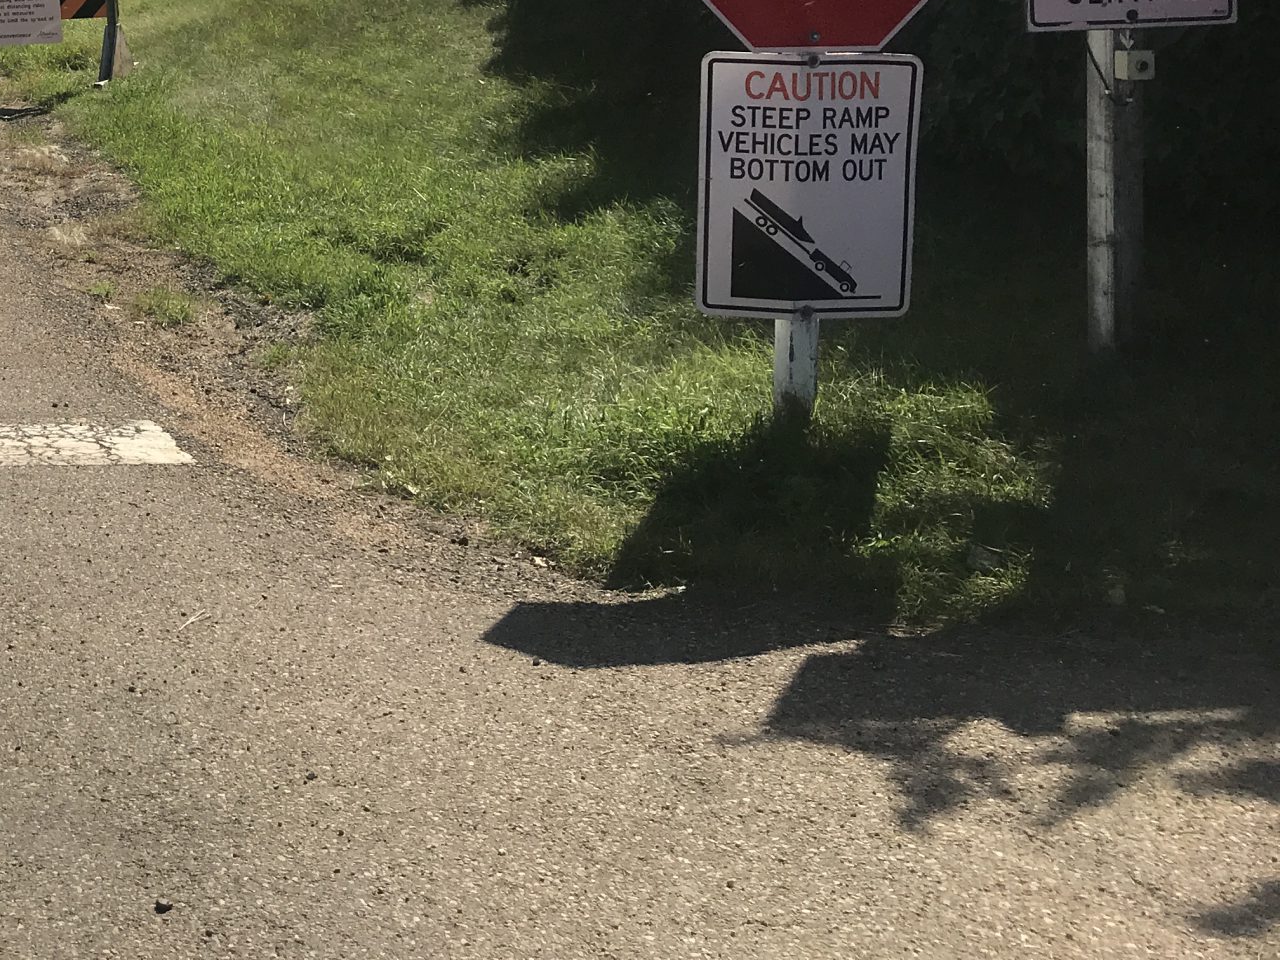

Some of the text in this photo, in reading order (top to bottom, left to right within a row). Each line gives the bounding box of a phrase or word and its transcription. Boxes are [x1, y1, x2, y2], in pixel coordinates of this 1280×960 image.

[744, 70, 881, 101] CAUTION
[731, 105, 890, 130] STEEP RAMP
[717, 131, 901, 156] VEHICLES MAY
[730, 158, 888, 182] BOTTOM OUT
